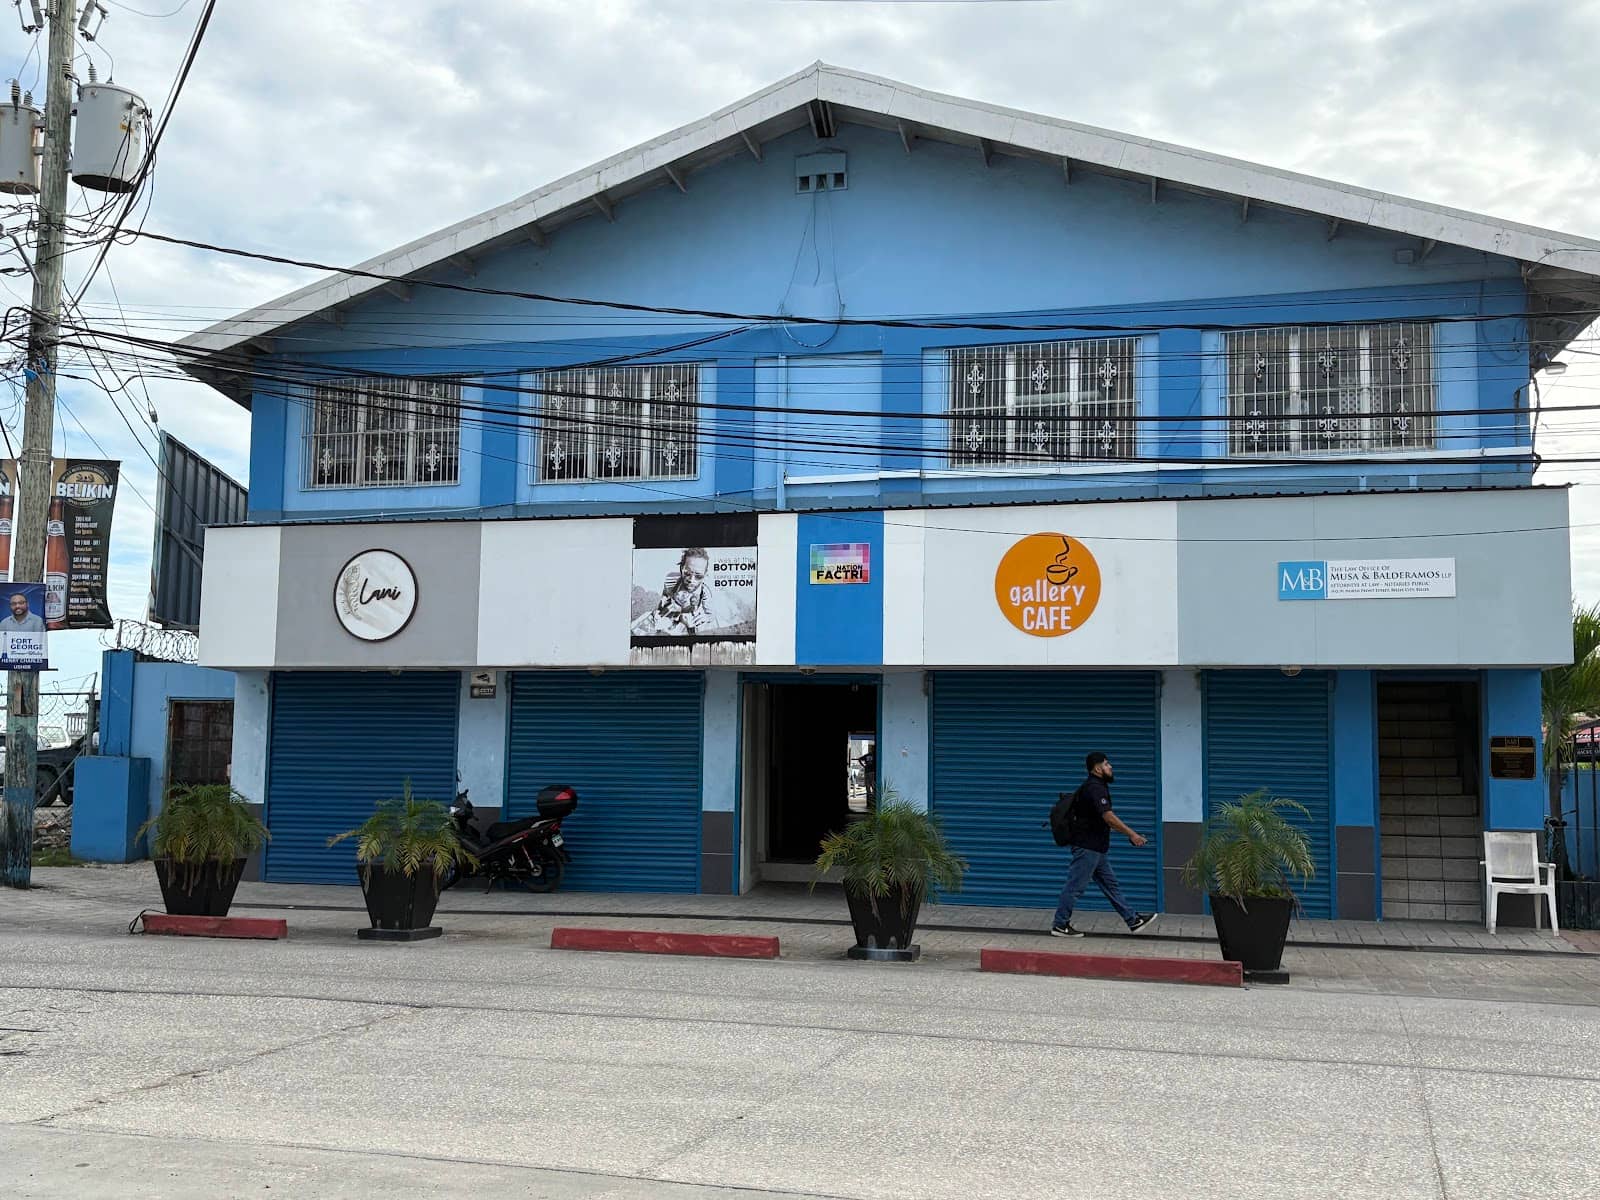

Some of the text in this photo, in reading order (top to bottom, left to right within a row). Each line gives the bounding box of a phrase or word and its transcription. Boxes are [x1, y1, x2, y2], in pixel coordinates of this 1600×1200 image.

[56, 481, 113, 498] BELIKIN
[713, 563, 756, 571] BOTTOM
[816, 570, 863, 580] FACTRI
[1330, 573, 1359, 581] MUSA
[1361, 571, 1370, 580] &
[1373, 570, 1440, 580] BALDERAMOS
[714, 579, 753, 587] BOTTOM
[1280, 567, 1324, 592] M&B
[359, 578, 401, 605] Lani
[1009, 579, 1086, 606] gallery
[1022, 606, 1072, 630] CAFE
